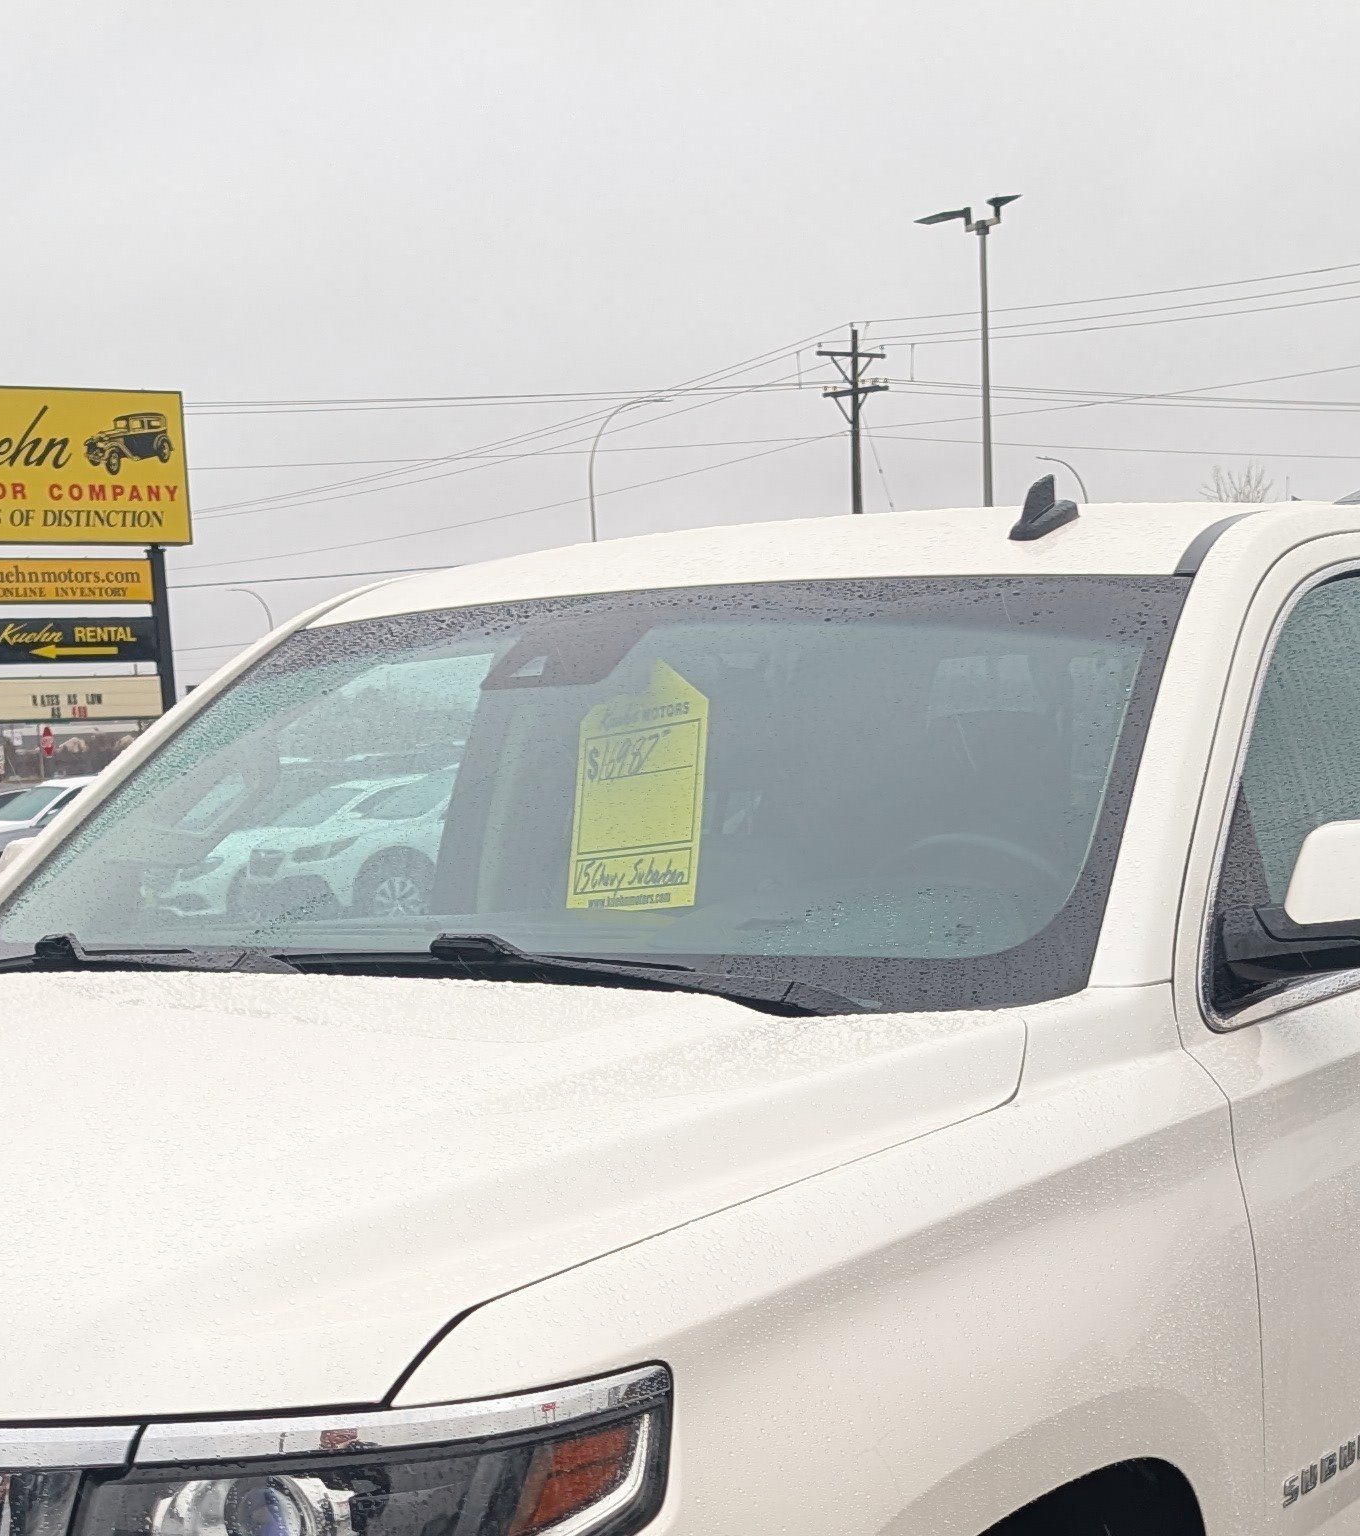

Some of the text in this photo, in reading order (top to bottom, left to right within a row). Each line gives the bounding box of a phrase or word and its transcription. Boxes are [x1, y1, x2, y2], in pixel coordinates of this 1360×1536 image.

[48, 484, 179, 502] COMPANY
[9, 508, 35, 527] OF
[42, 509, 165, 528] DISTINCTION
[55, 587, 128, 598] INVENTORY
[74, 626, 137, 642] RENTAL
[641, 701, 690, 721] MOTORS
